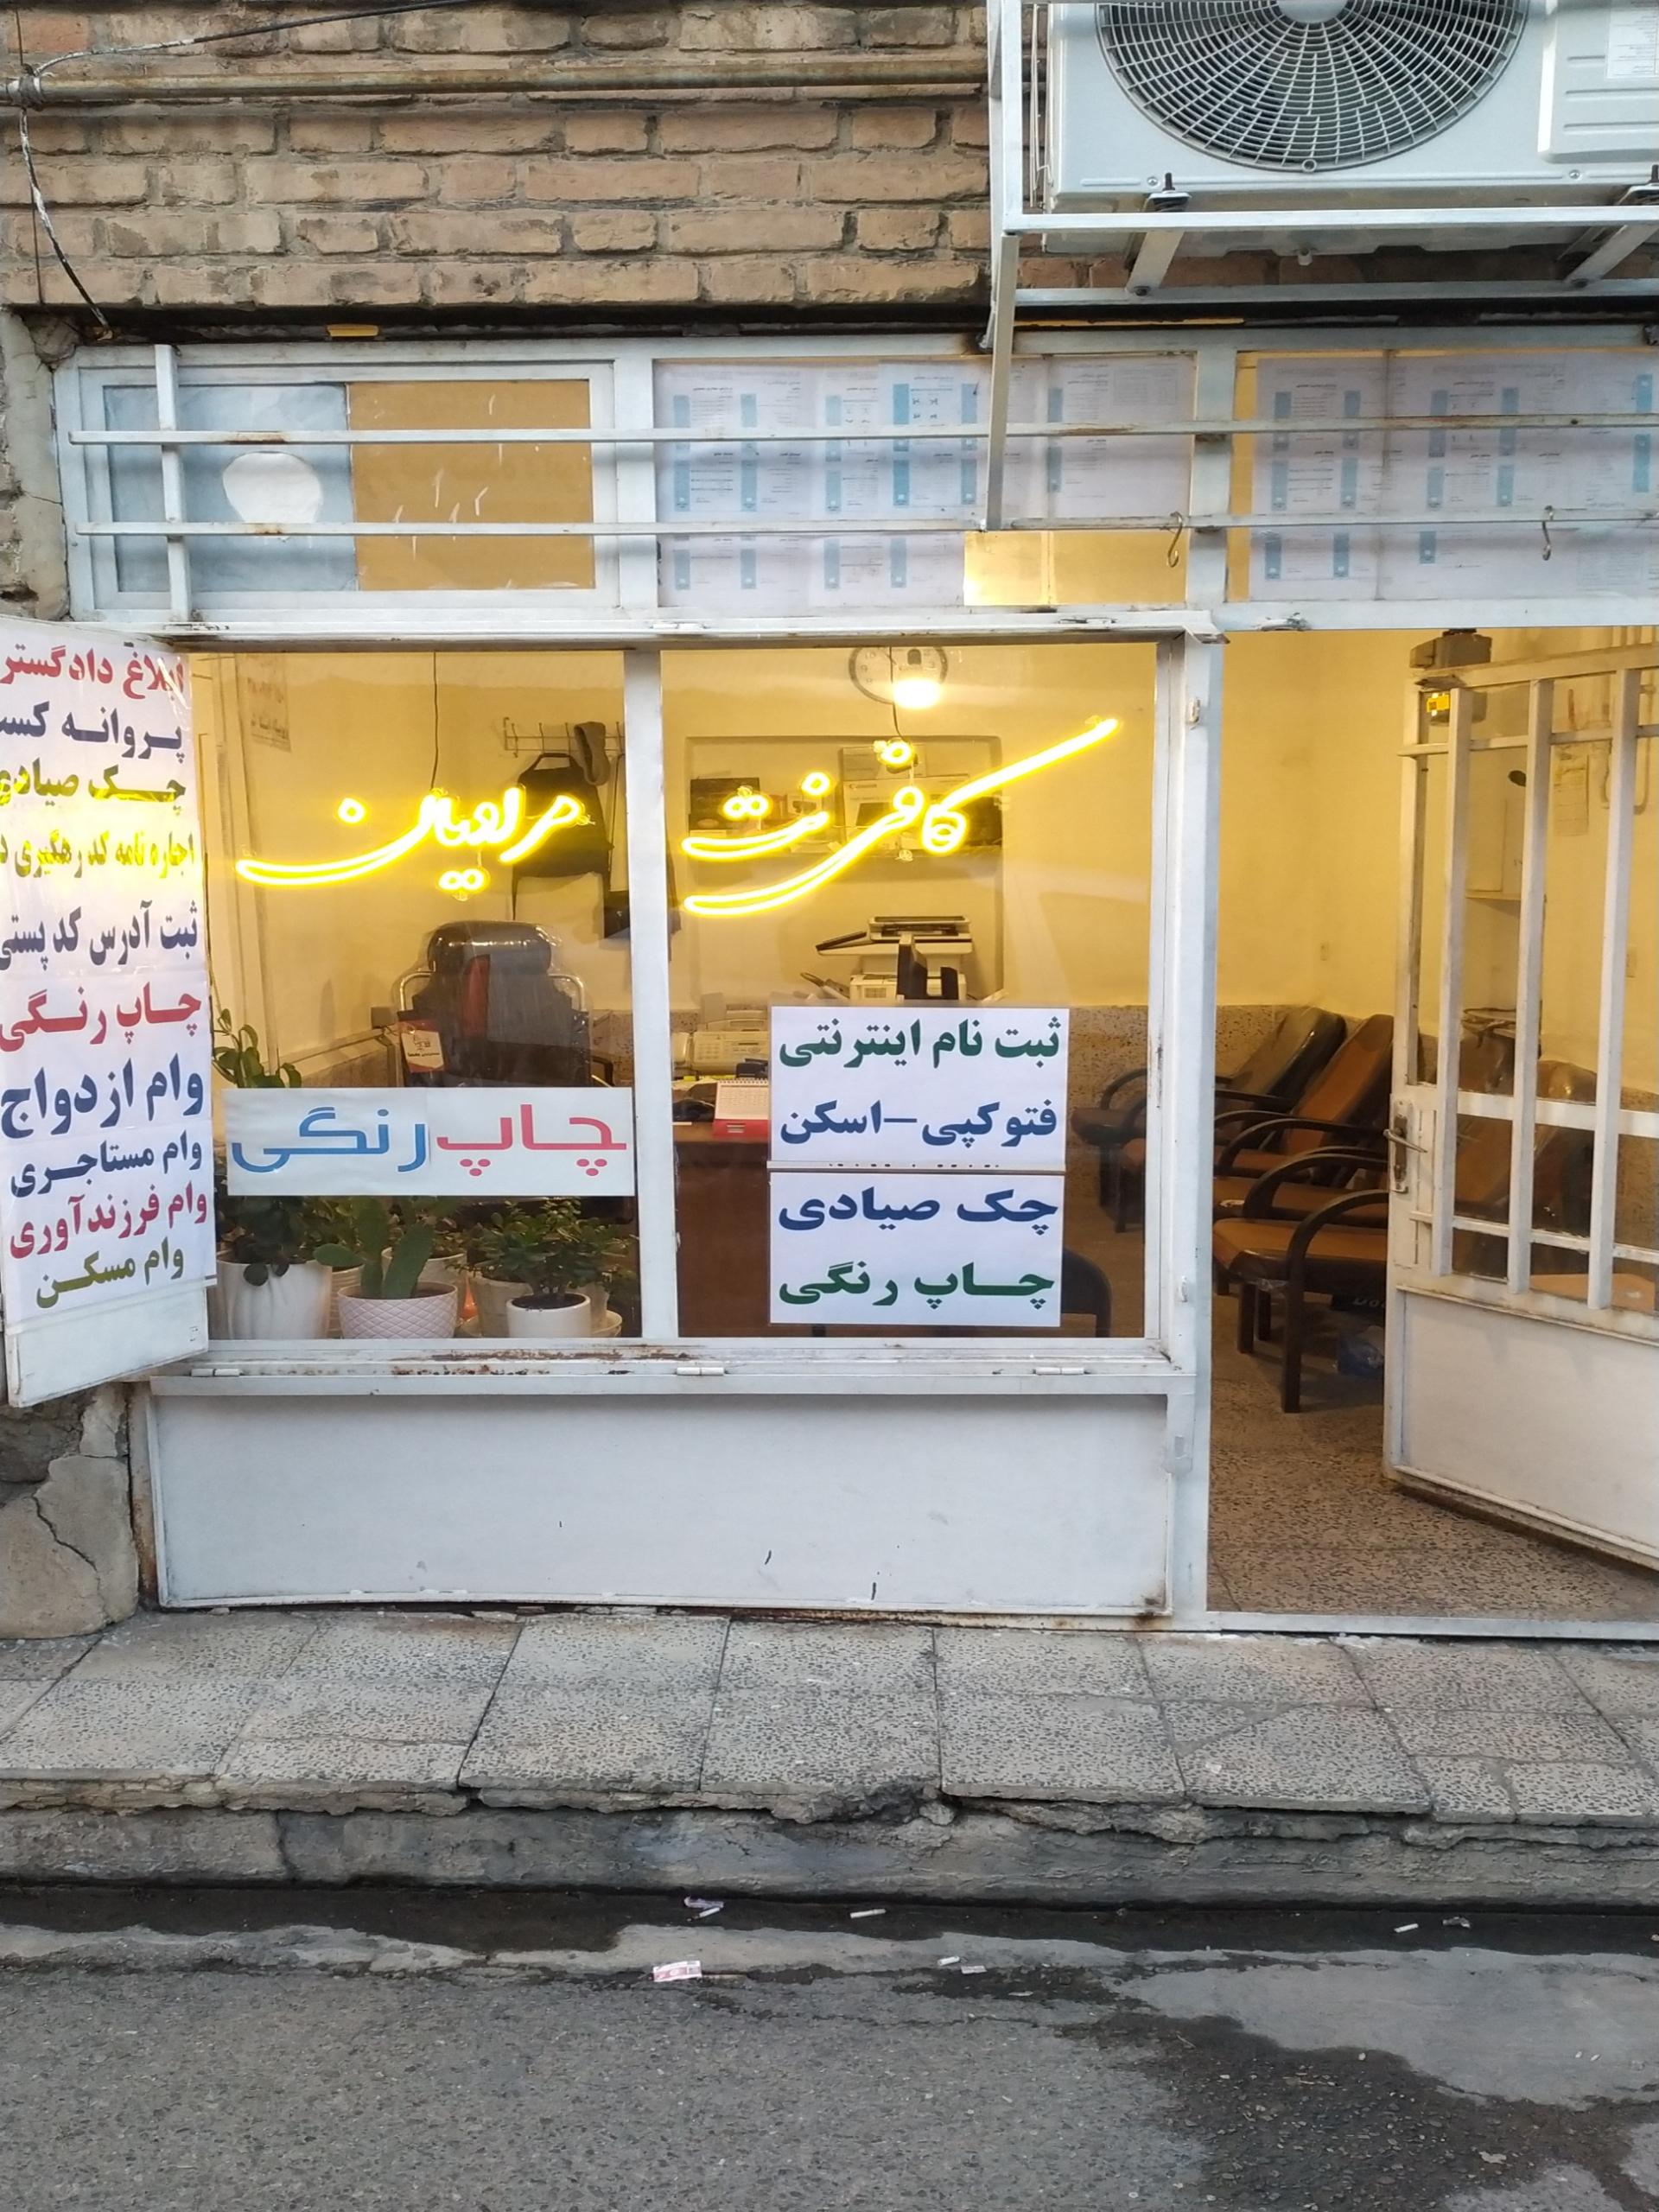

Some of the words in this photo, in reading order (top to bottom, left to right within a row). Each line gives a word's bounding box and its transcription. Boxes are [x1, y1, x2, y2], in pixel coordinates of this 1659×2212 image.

[61, 706, 183, 764] پروانه
[88, 764, 187, 816] چک
[89, 899, 152, 966] آدرس
[160, 900, 199, 960] ثبت
[0, 987, 107, 1052] رنگی
[117, 981, 202, 1045] چاپ
[779, 1017, 921, 1068] اینترنتی
[932, 1018, 983, 1069] نام
[995, 1015, 1062, 1069] ثبت
[1, 1057, 134, 1140] ازدواج
[146, 1052, 204, 1122] وام
[162, 1128, 202, 1174] وام
[230, 1106, 427, 1173] رنگی
[435, 1103, 628, 1178] چاپ
[10, 1140, 155, 1198] مستاجری
[168, 1179, 207, 1230] وام
[778, 1185, 941, 1231] صیادی
[956, 1188, 1059, 1236] چک
[35, 1249, 137, 1309] مسکن
[143, 1236, 185, 1287] وام
[779, 1260, 899, 1306] رنگی
[913, 1261, 1057, 1311] چاپ
